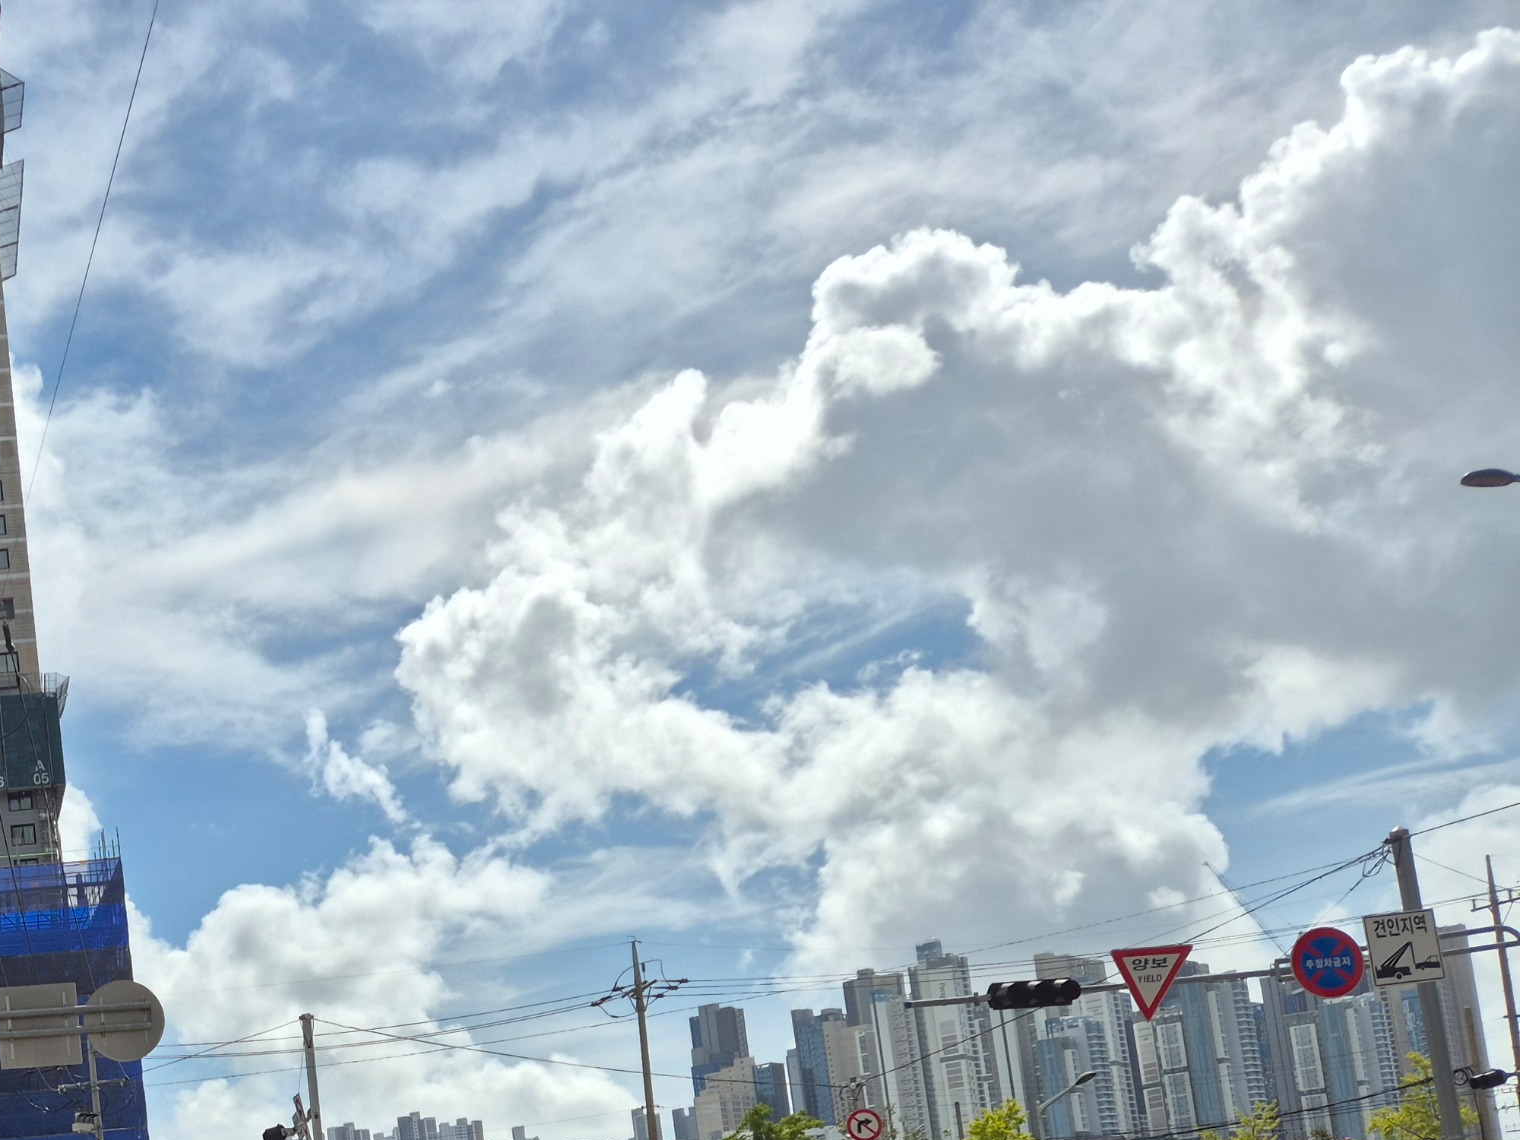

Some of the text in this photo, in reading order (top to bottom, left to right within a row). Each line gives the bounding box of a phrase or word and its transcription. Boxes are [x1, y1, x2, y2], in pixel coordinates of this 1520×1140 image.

[33, 772, 50, 785] 05
[1372, 913, 1429, 938] 견인지역
[1131, 956, 1170, 972] 양보
[1305, 956, 1351, 971] 주정차금지
[1137, 973, 1163, 985] YIELD
